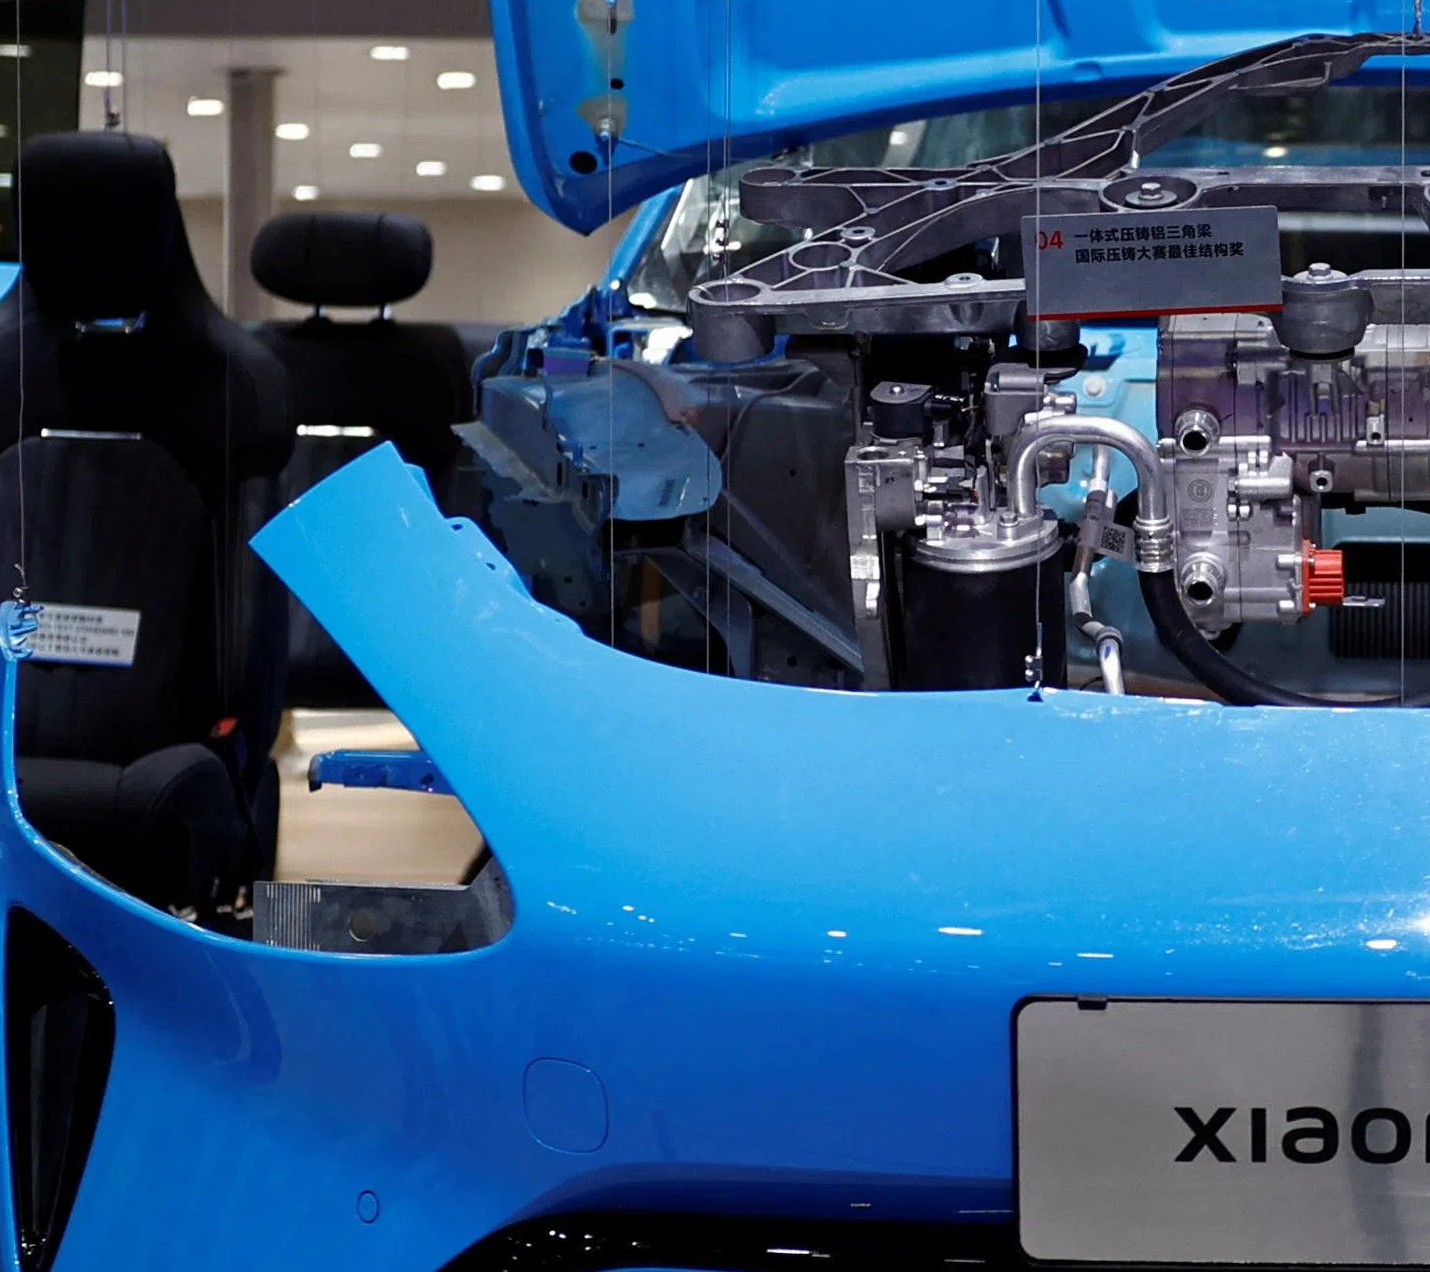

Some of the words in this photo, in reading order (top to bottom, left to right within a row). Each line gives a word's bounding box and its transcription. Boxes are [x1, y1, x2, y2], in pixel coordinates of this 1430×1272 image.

[1034, 230, 1064, 249] 04
[1073, 224, 1212, 242] 一体式压铸铝三角梁
[1075, 242, 1244, 263] 国际压铸大赛最佳结构奖
